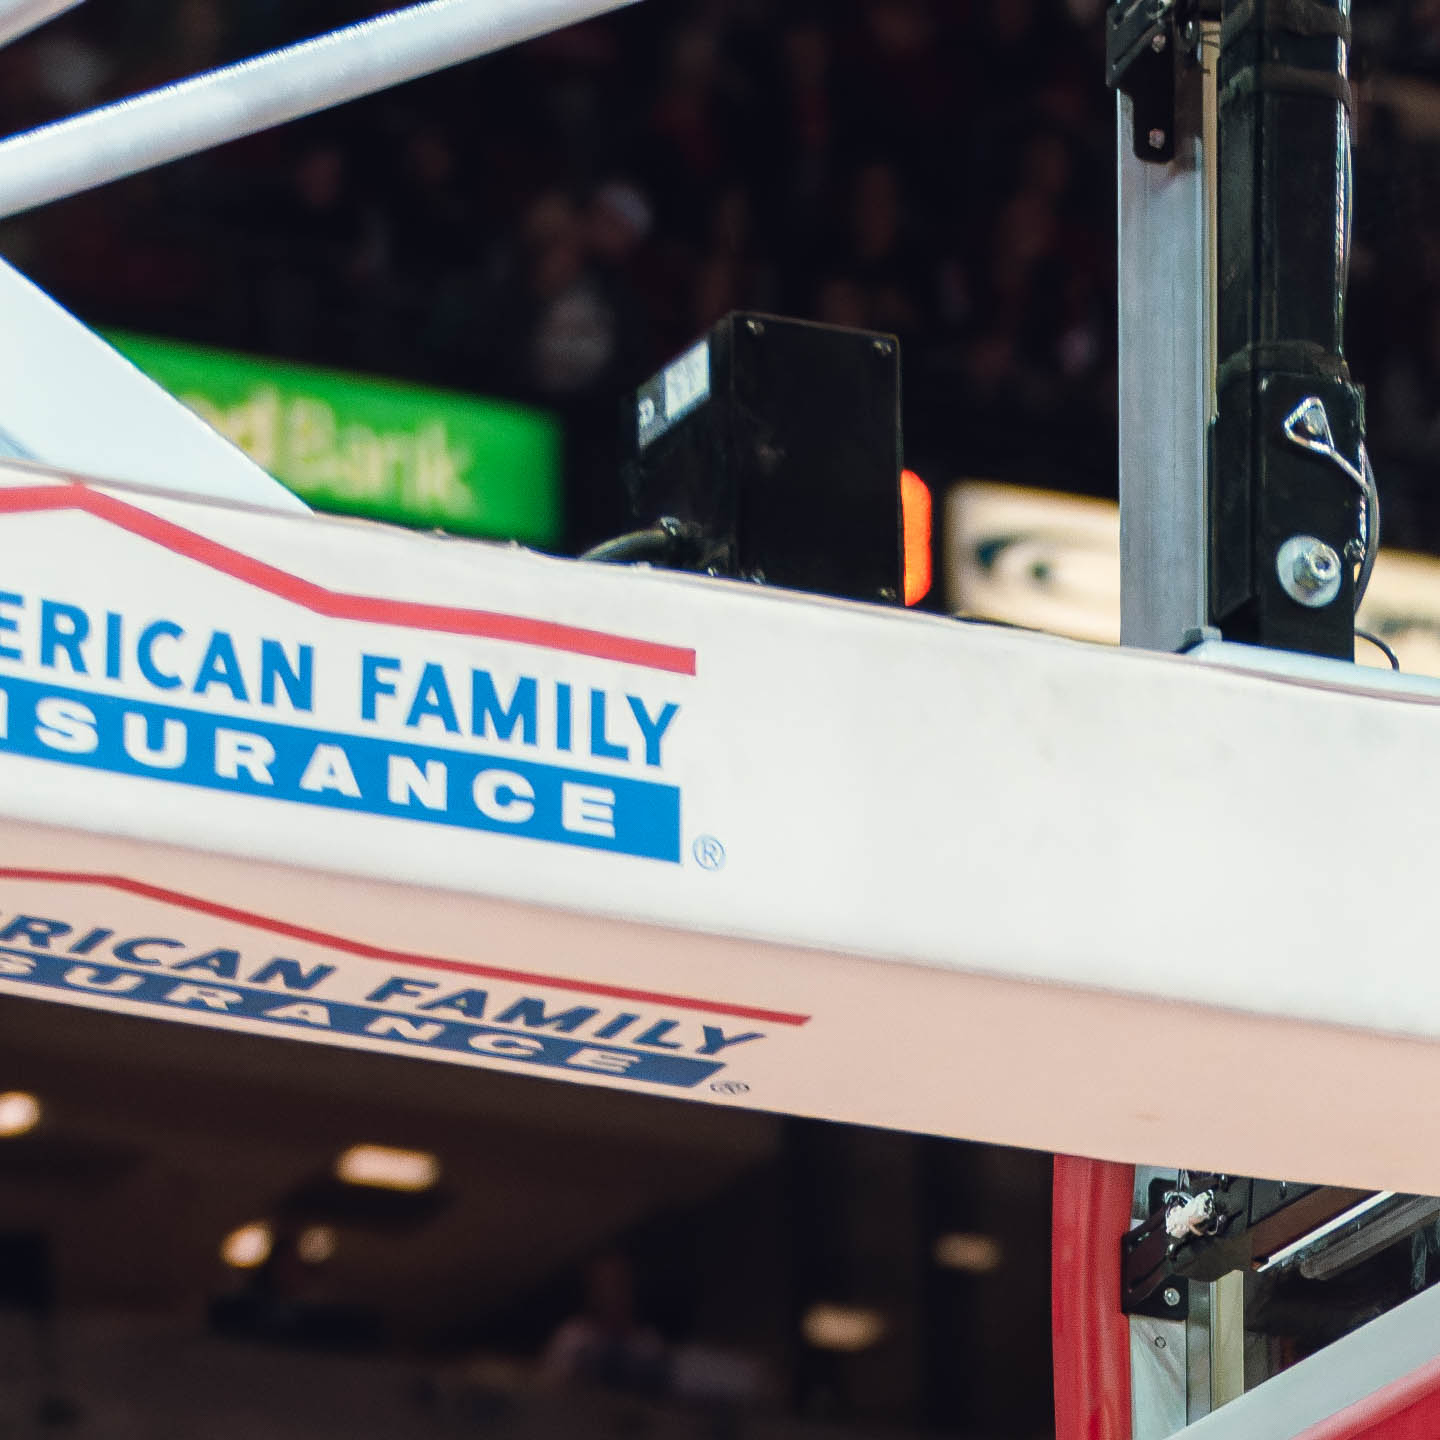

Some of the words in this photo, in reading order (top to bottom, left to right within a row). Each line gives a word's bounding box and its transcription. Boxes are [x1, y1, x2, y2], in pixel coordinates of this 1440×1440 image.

[0, 686, 616, 840] SURANCE
[361, 652, 680, 768] FAMILY
[364, 976, 767, 1055] FAMILY
